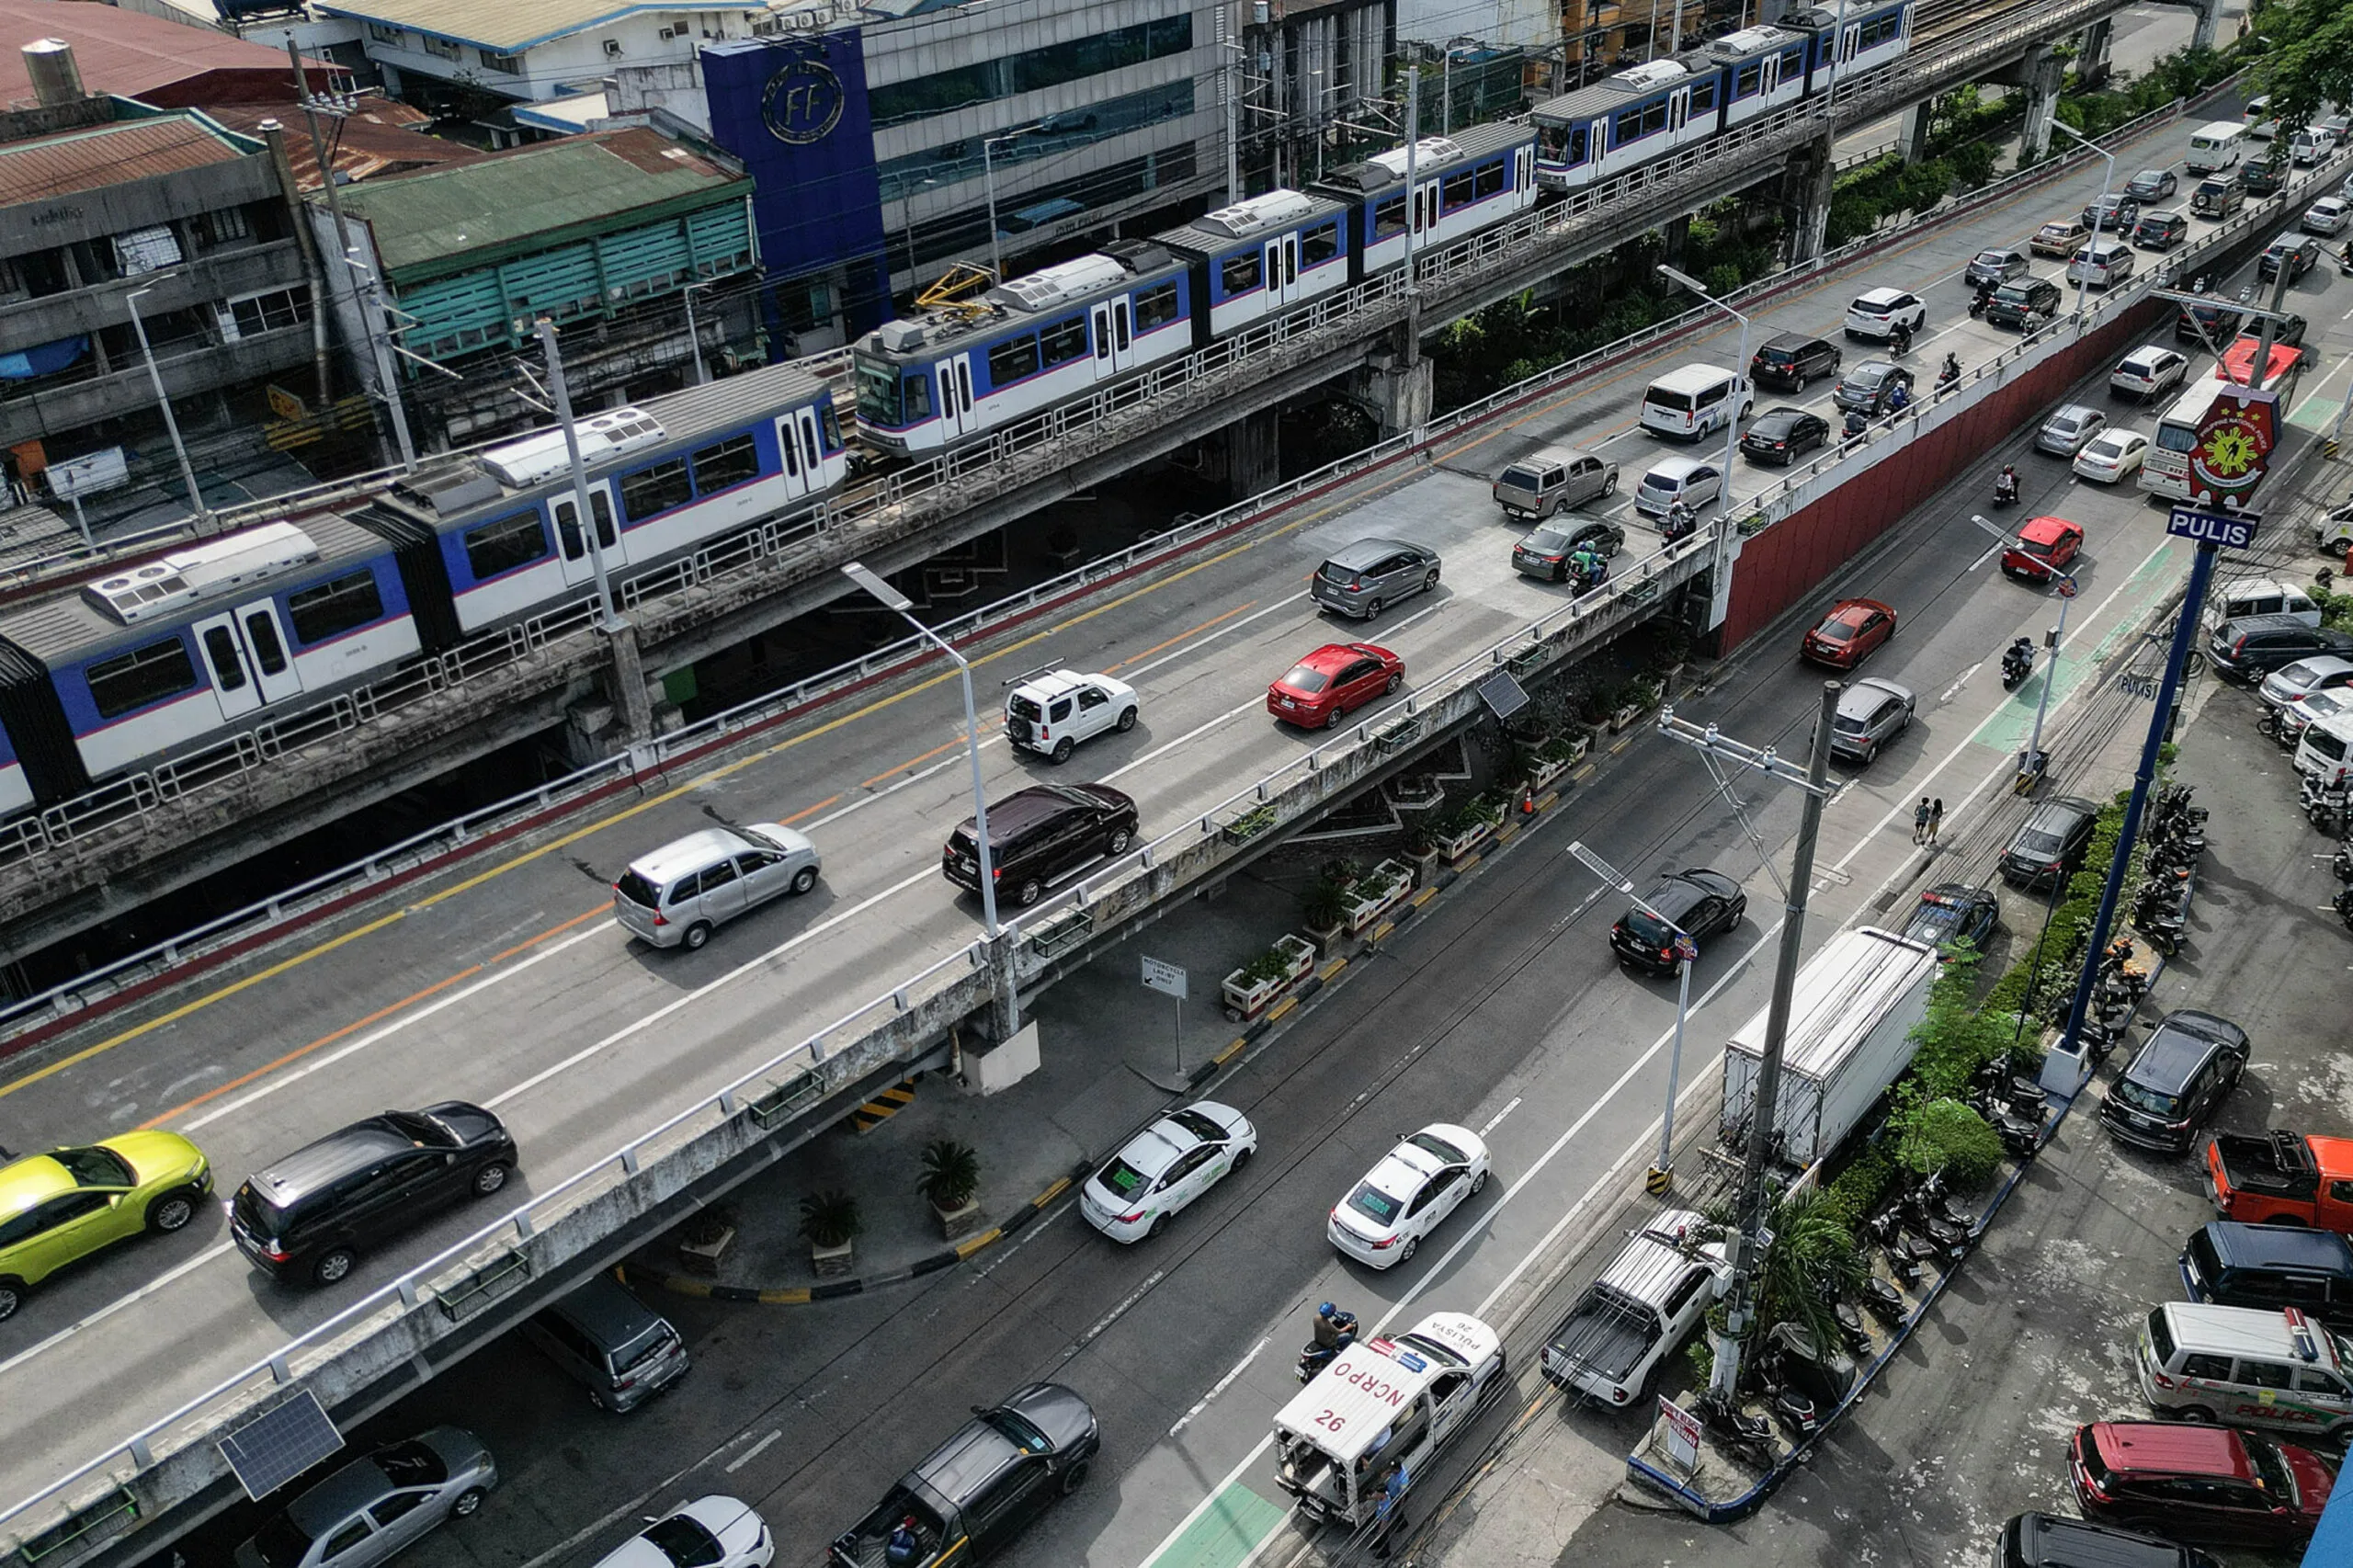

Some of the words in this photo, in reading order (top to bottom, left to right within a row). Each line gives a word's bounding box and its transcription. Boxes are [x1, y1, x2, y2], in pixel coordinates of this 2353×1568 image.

[785, 83, 824, 126] FF
[2229, 417, 2257, 432] NATIONAL
[2256, 429, 2268, 449] POLICE
[2171, 515, 2247, 544] PULIS
[1143, 958, 1185, 976] MOTORCYCLE
[1155, 975, 1173, 985] ONLY
[1432, 1322, 1481, 1350] PULISYA
[1334, 1362, 1405, 1407] NCRPO
[1314, 1408, 1347, 1432] 26
[2235, 1403, 2323, 1423] POLICE
